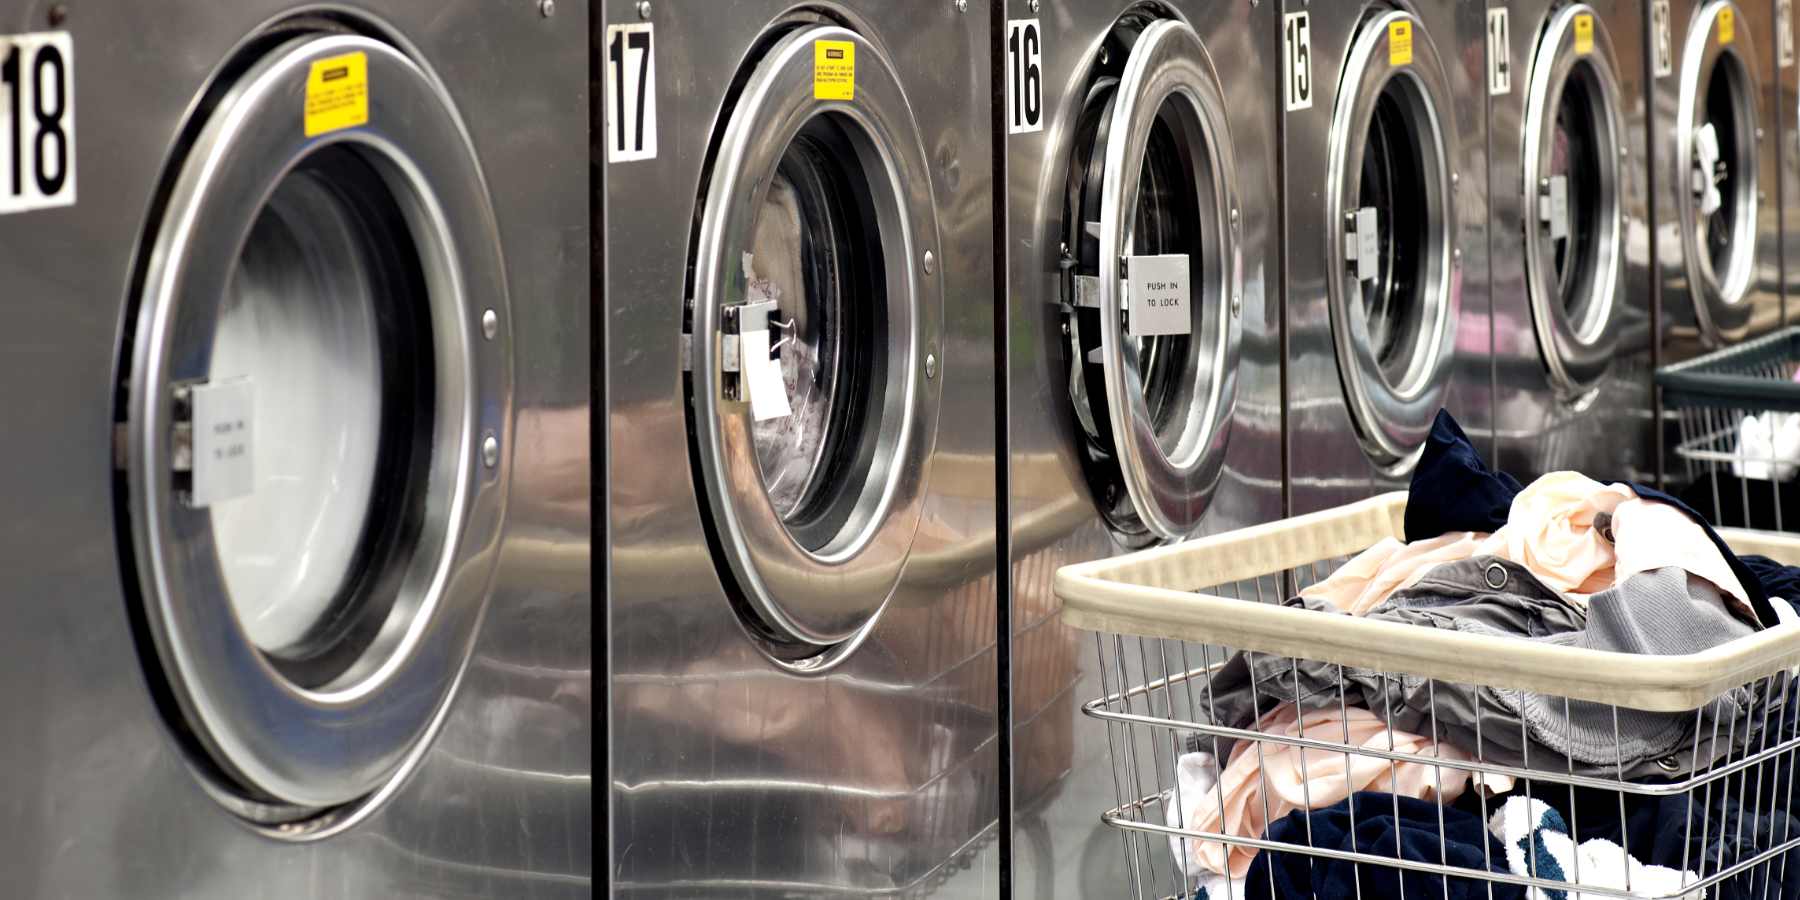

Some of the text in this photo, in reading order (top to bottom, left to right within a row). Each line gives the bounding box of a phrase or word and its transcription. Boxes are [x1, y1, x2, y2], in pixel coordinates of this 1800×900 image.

[610, 31, 650, 152] 17
[1009, 24, 1040, 127] 16
[1287, 16, 1310, 104] 15
[1490, 14, 1509, 88] 14
[2, 44, 67, 196] 18
[1147, 282, 1178, 291] PUSH IN
[1147, 298, 1179, 307] TO LOCK
